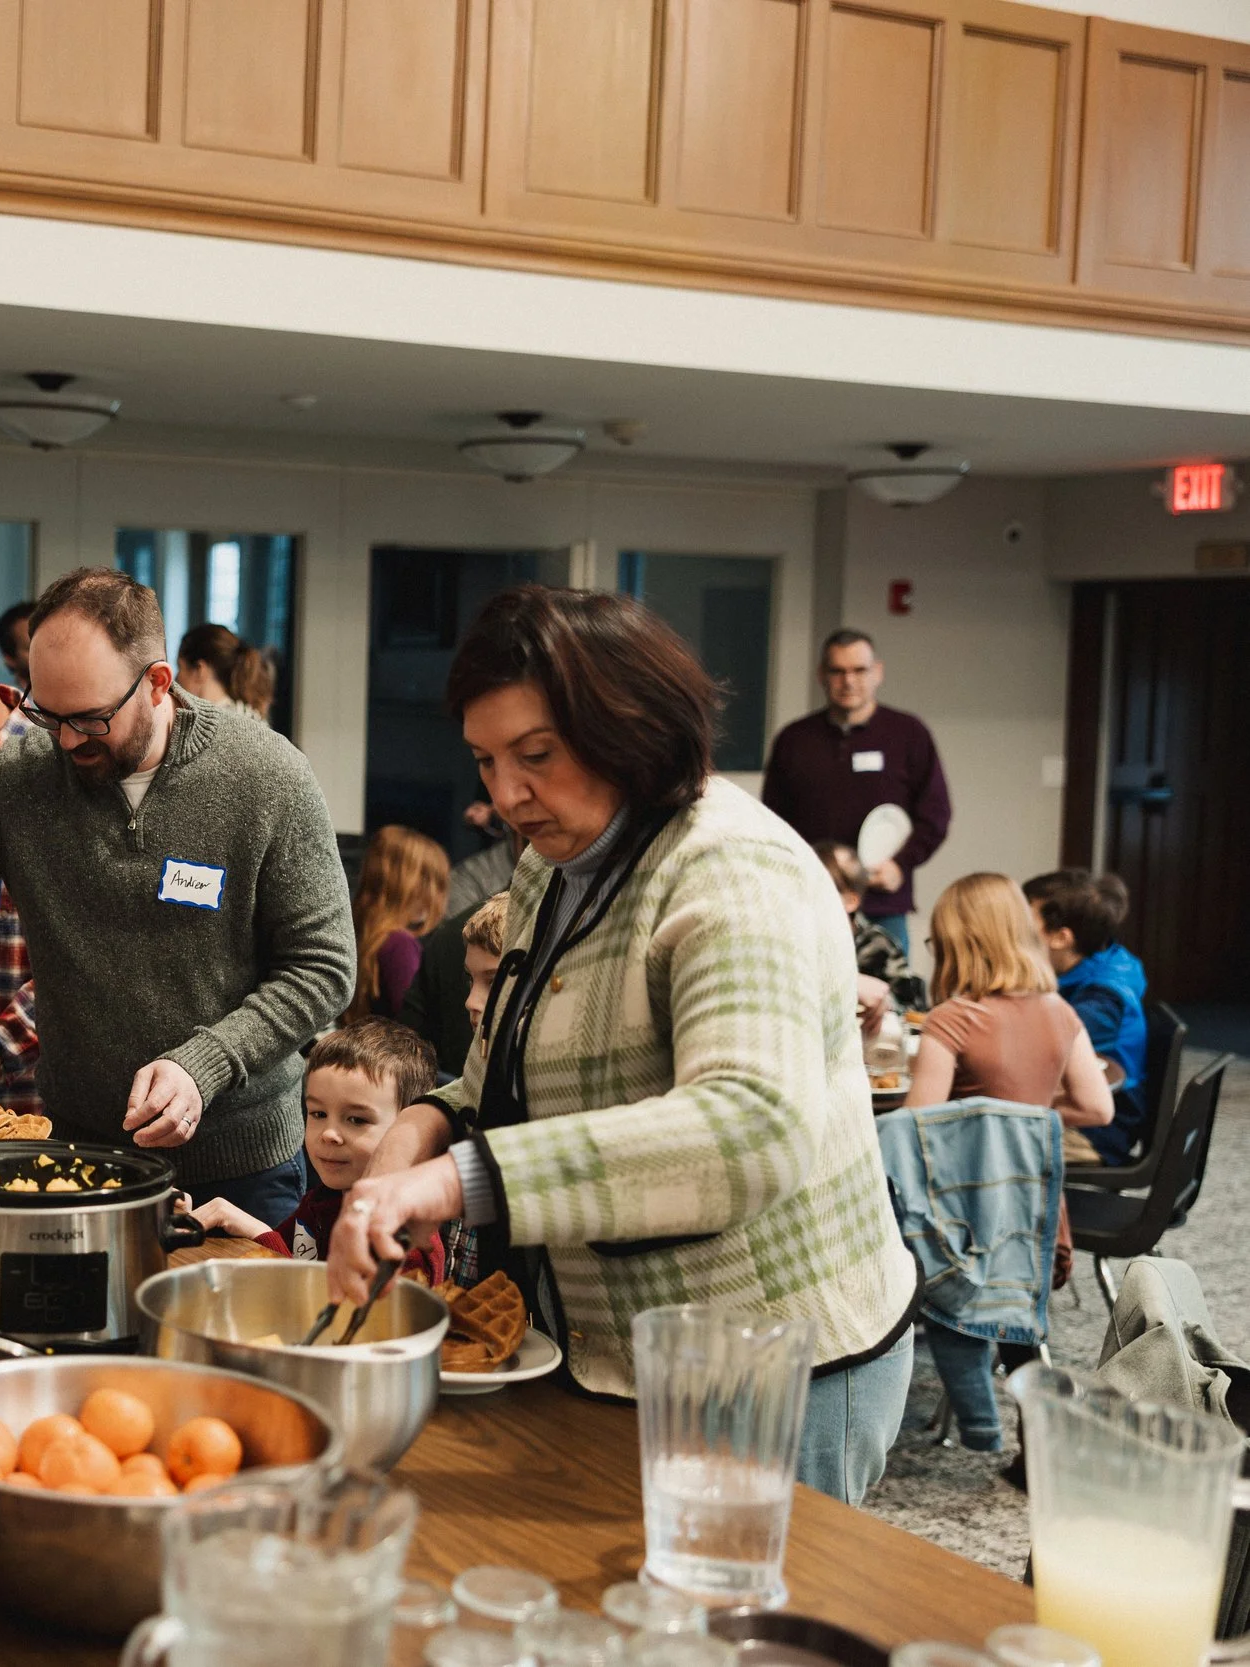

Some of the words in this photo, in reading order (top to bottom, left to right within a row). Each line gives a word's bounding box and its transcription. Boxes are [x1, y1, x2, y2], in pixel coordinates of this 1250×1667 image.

[1174, 465, 1224, 510] EXIT
[170, 869, 211, 890] Andrew
[29, 1229, 84, 1243] crockpot
